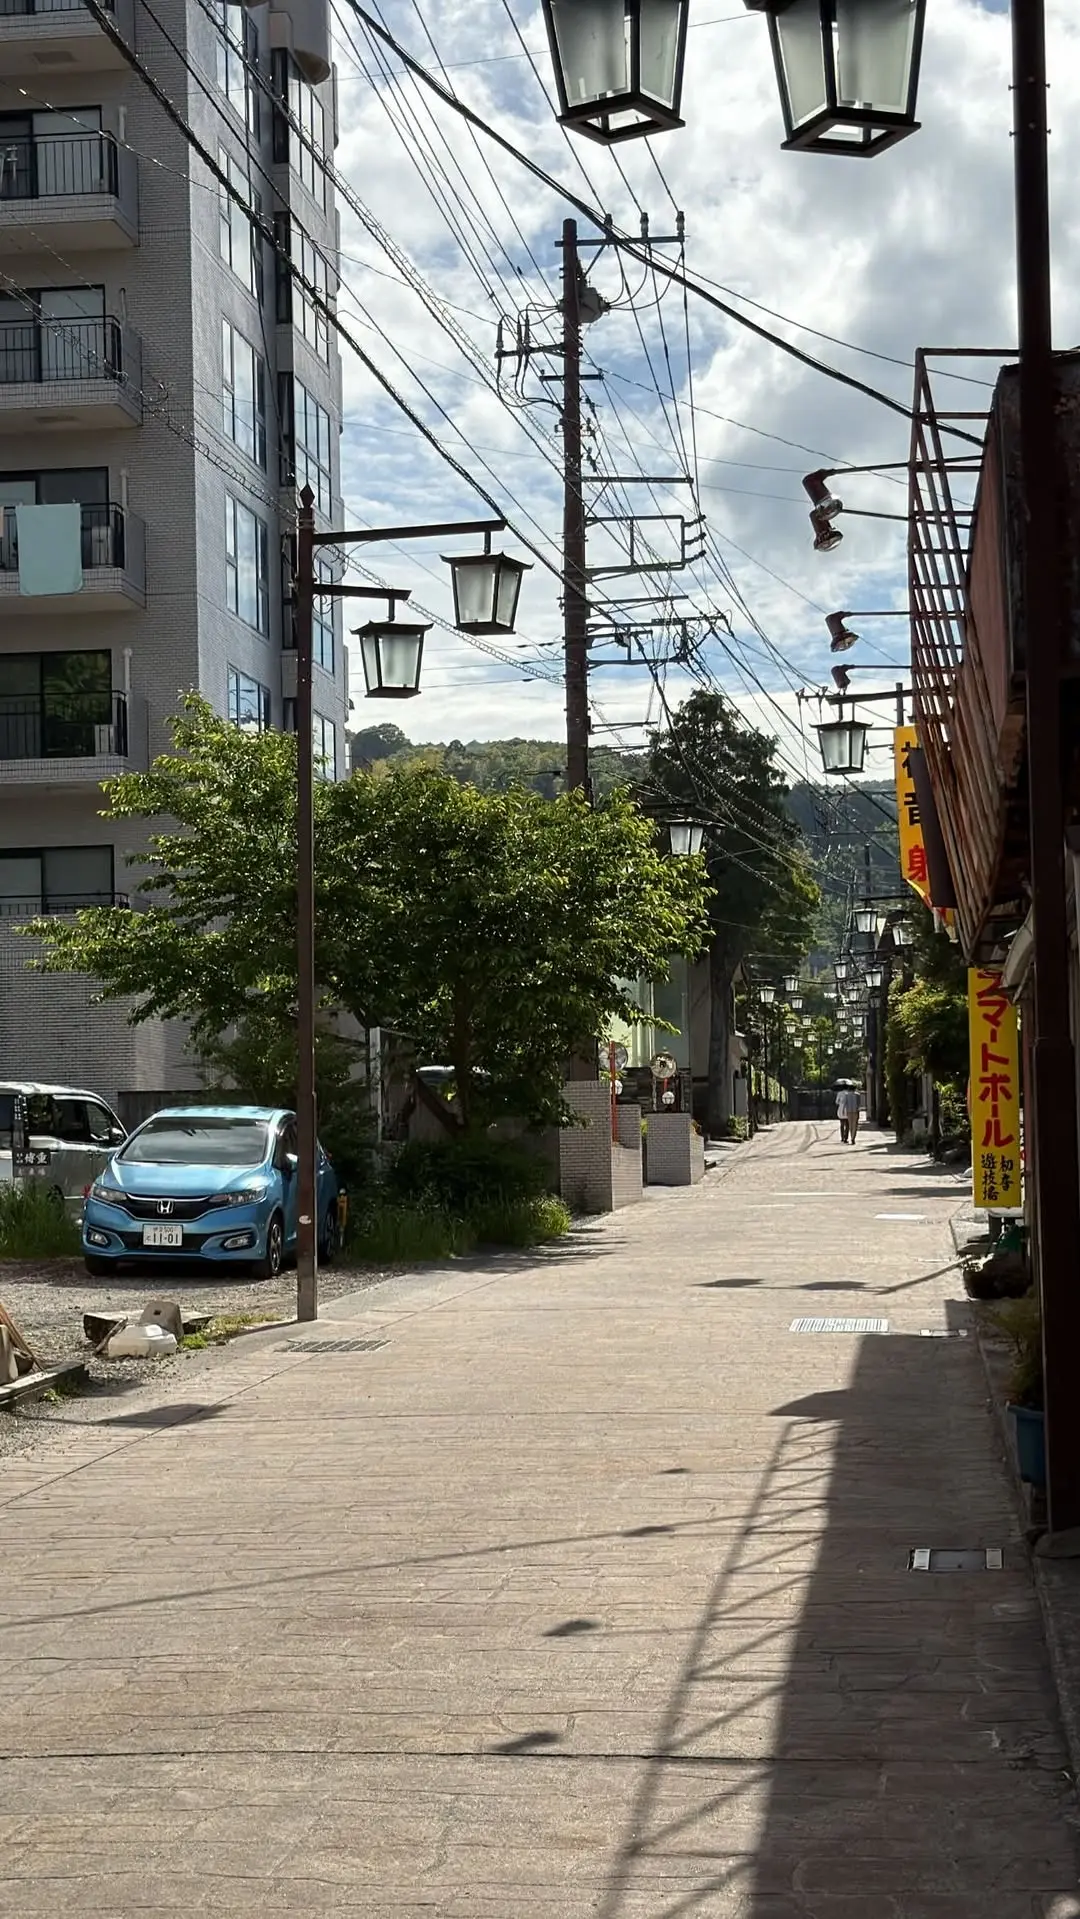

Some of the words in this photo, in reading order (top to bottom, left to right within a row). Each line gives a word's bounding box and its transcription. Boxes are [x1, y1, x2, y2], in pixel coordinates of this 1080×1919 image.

[976, 970, 1014, 1148] スマートボール
